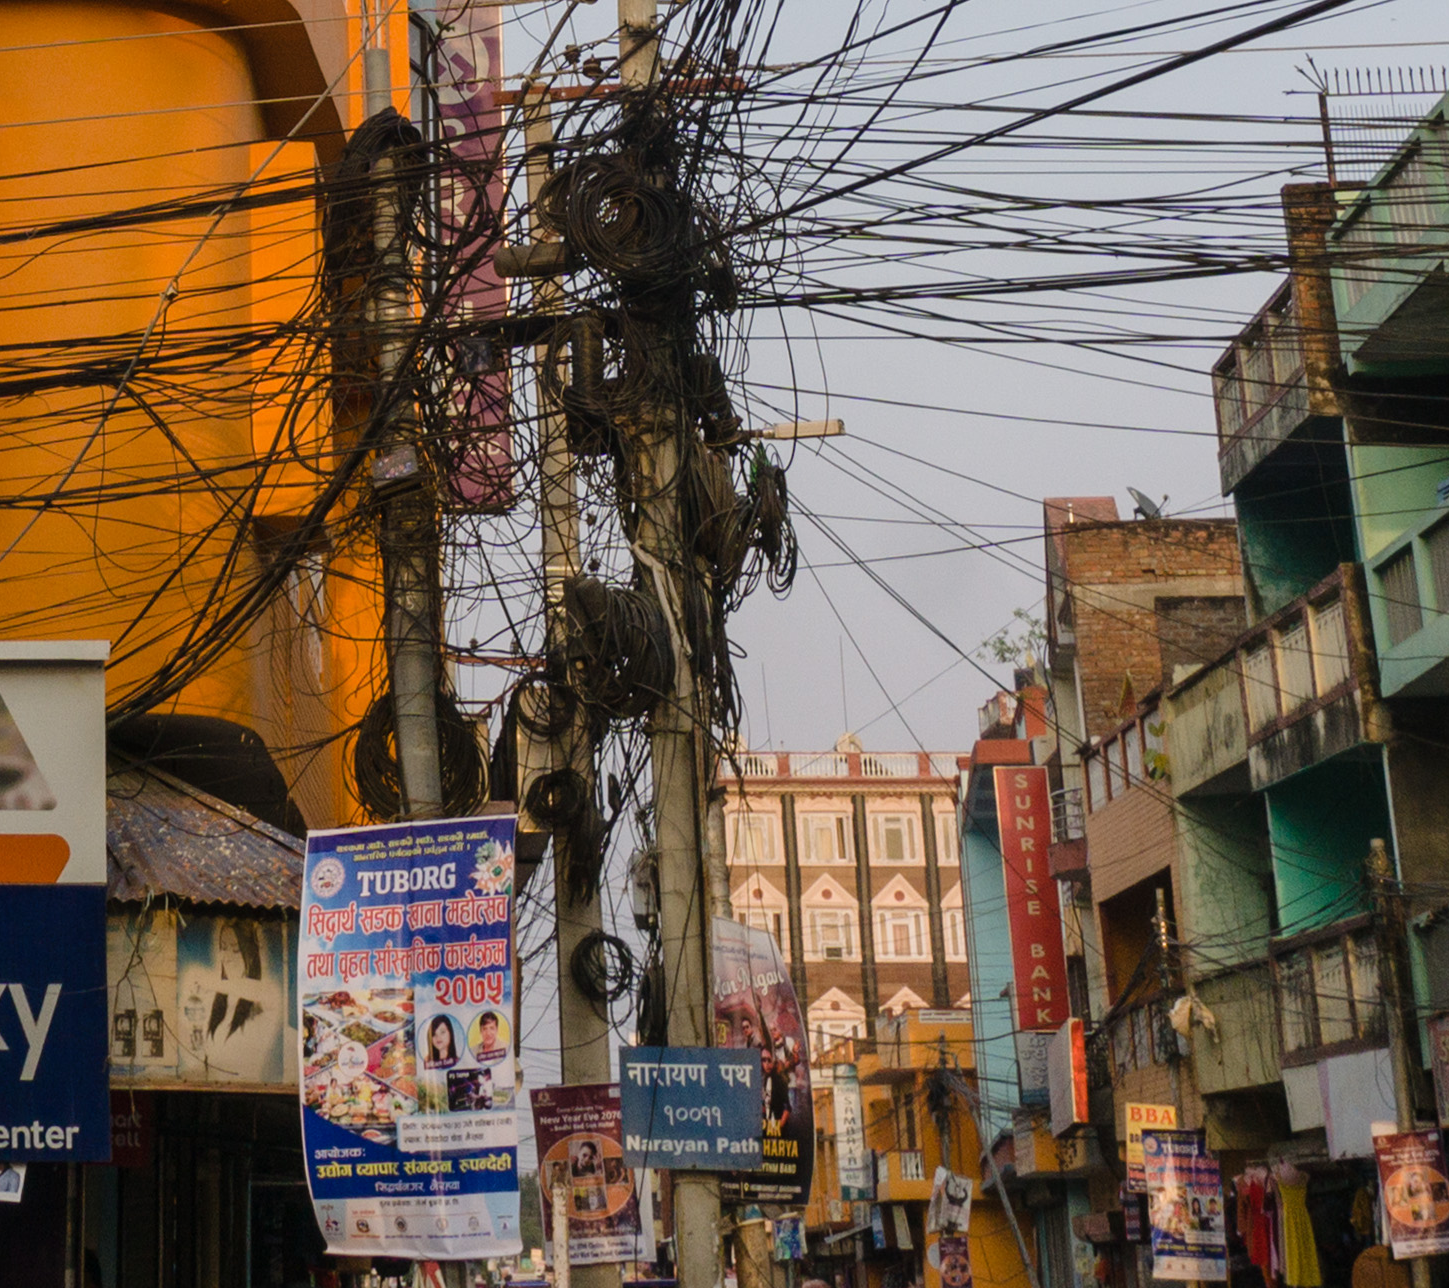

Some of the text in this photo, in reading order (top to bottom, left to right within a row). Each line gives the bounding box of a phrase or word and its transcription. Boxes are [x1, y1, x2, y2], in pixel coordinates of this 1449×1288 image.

[356, 862, 457, 898] TUBORG
[358, 903, 404, 935] सडक
[407, 899, 444, 930] खाना
[445, 889, 510, 926] महोत्सव
[1013, 773, 1044, 916] SUNRISE
[1029, 944, 1054, 1024] BANK
[306, 951, 336, 980] तथा
[444, 933, 507, 971] कार्यक्रम
[434, 972, 505, 1006] २०७५
[626, 1061, 753, 1088] नारायण पथ
[539, 1116, 561, 1125] New
[562, 1114, 582, 1123] Year
[583, 1113, 600, 1121] Eve
[664, 1104, 723, 1127] १००११
[1130, 1106, 1174, 1125] BBA
[626, 1134, 760, 1154] Narayan Path
[316, 1160, 353, 1179] उद्योग
[355, 1160, 401, 1177] व्यापार
